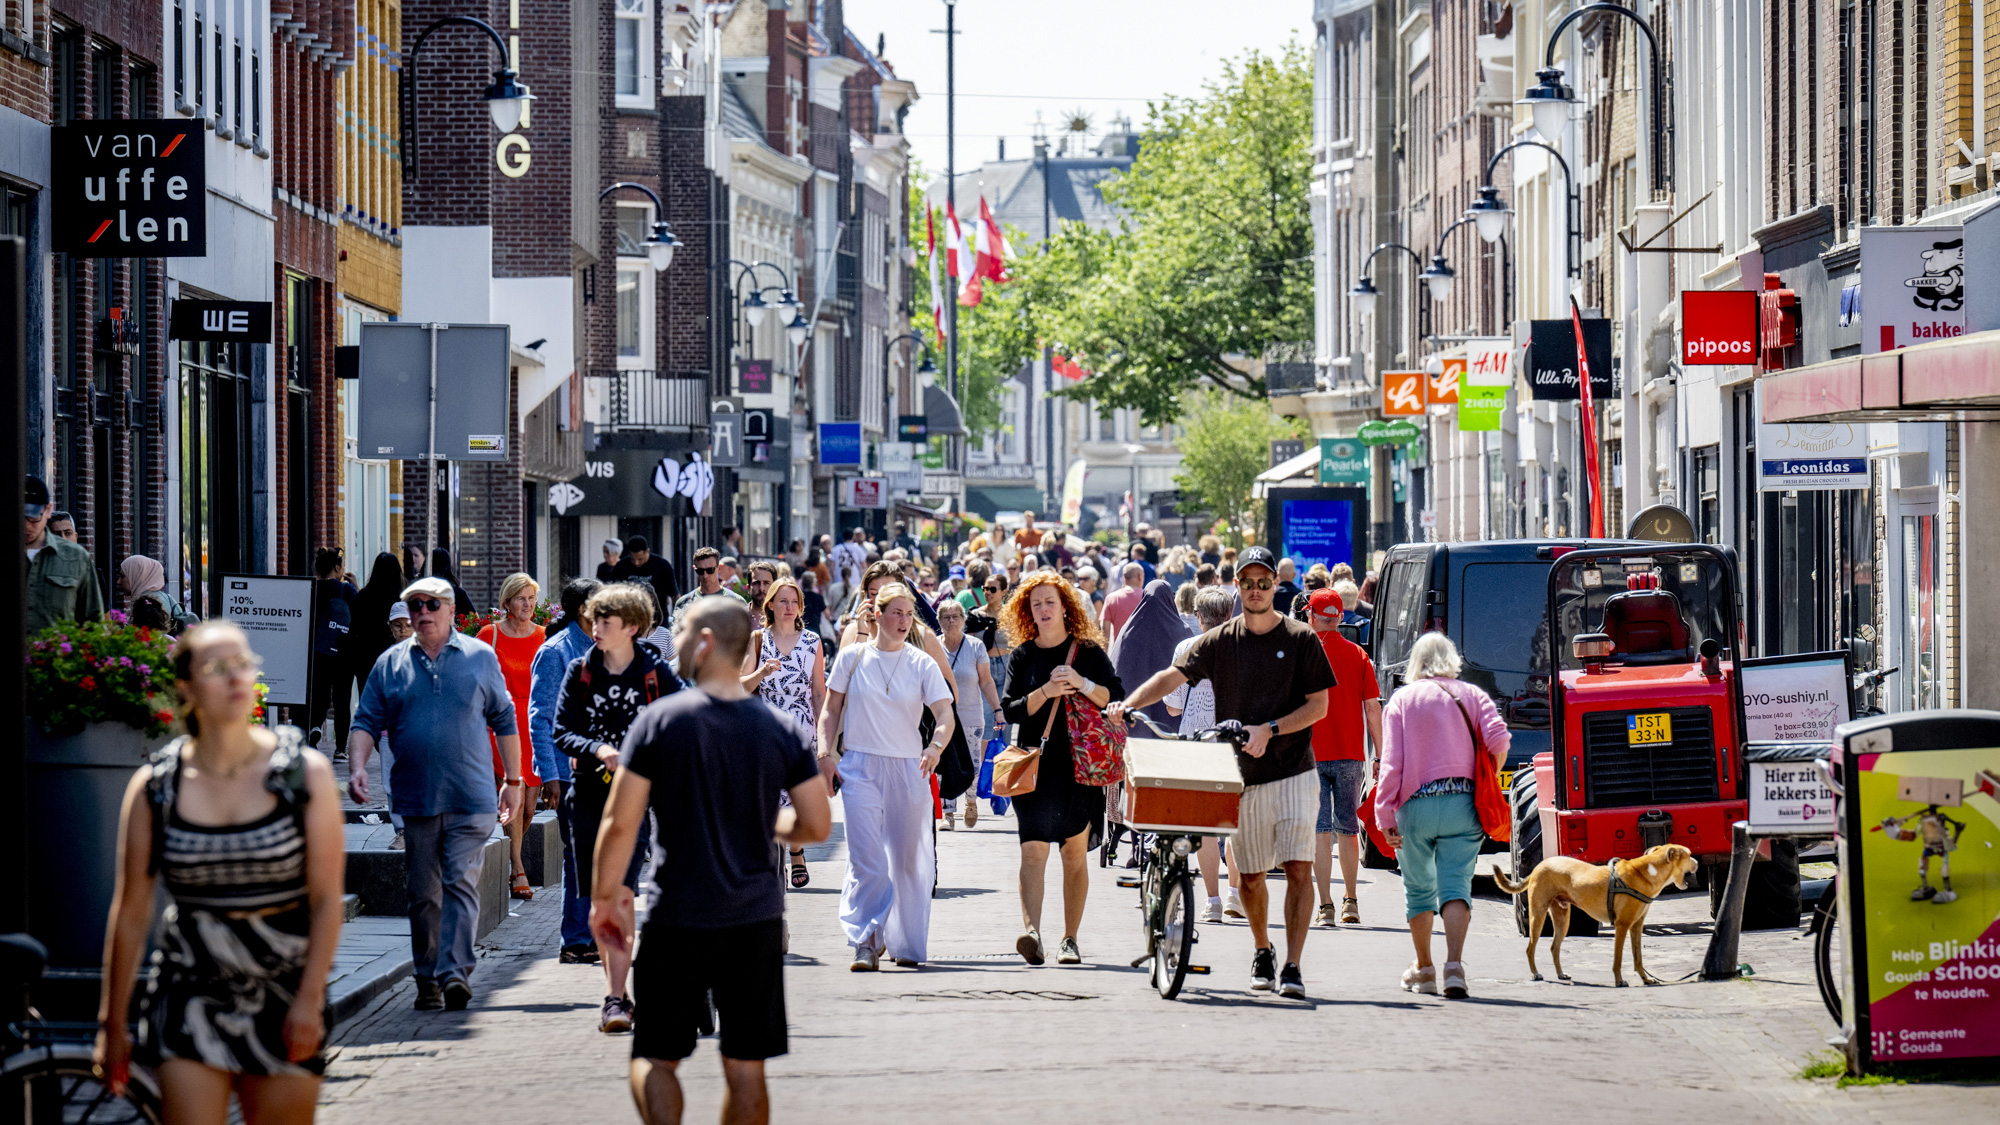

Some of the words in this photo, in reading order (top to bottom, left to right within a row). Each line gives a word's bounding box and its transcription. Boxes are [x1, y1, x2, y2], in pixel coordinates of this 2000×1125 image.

[84, 167, 188, 202] uffe
[119, 209, 188, 242] len
[203, 309, 249, 333] WE
[1687, 337, 1751, 357] pipoos
[1473, 352, 1508, 375] H&M
[1535, 369, 1560, 385] Ulla
[1561, 367, 1609, 389] Popen
[1362, 428, 1415, 444] Specsavers
[585, 461, 615, 478] VIS
[1323, 458, 1363, 471] Pearle
[1782, 460, 1850, 474] Leonidas
[230, 596, 254, 605] -10%
[230, 607, 249, 615] FOR
[252, 607, 303, 618] STUDENTS
[585, 685, 640, 718] JACK
[1637, 715, 1662, 728] TST
[1636, 729, 1665, 742] 33-N
[1764, 768, 1795, 783] Hier
[1798, 767, 1816, 782] zit
[1764, 786, 1817, 800] lekkers
[1891, 949, 1924, 964] Help
[1929, 938, 2000, 960] Blinki
[1884, 970, 1930, 983] Gouda
[1915, 989, 1929, 1000] te
[1932, 986, 1990, 1000] houden.
[1899, 1029, 1966, 1040] Gemeente
[1900, 1042, 1943, 1054] Gouda
